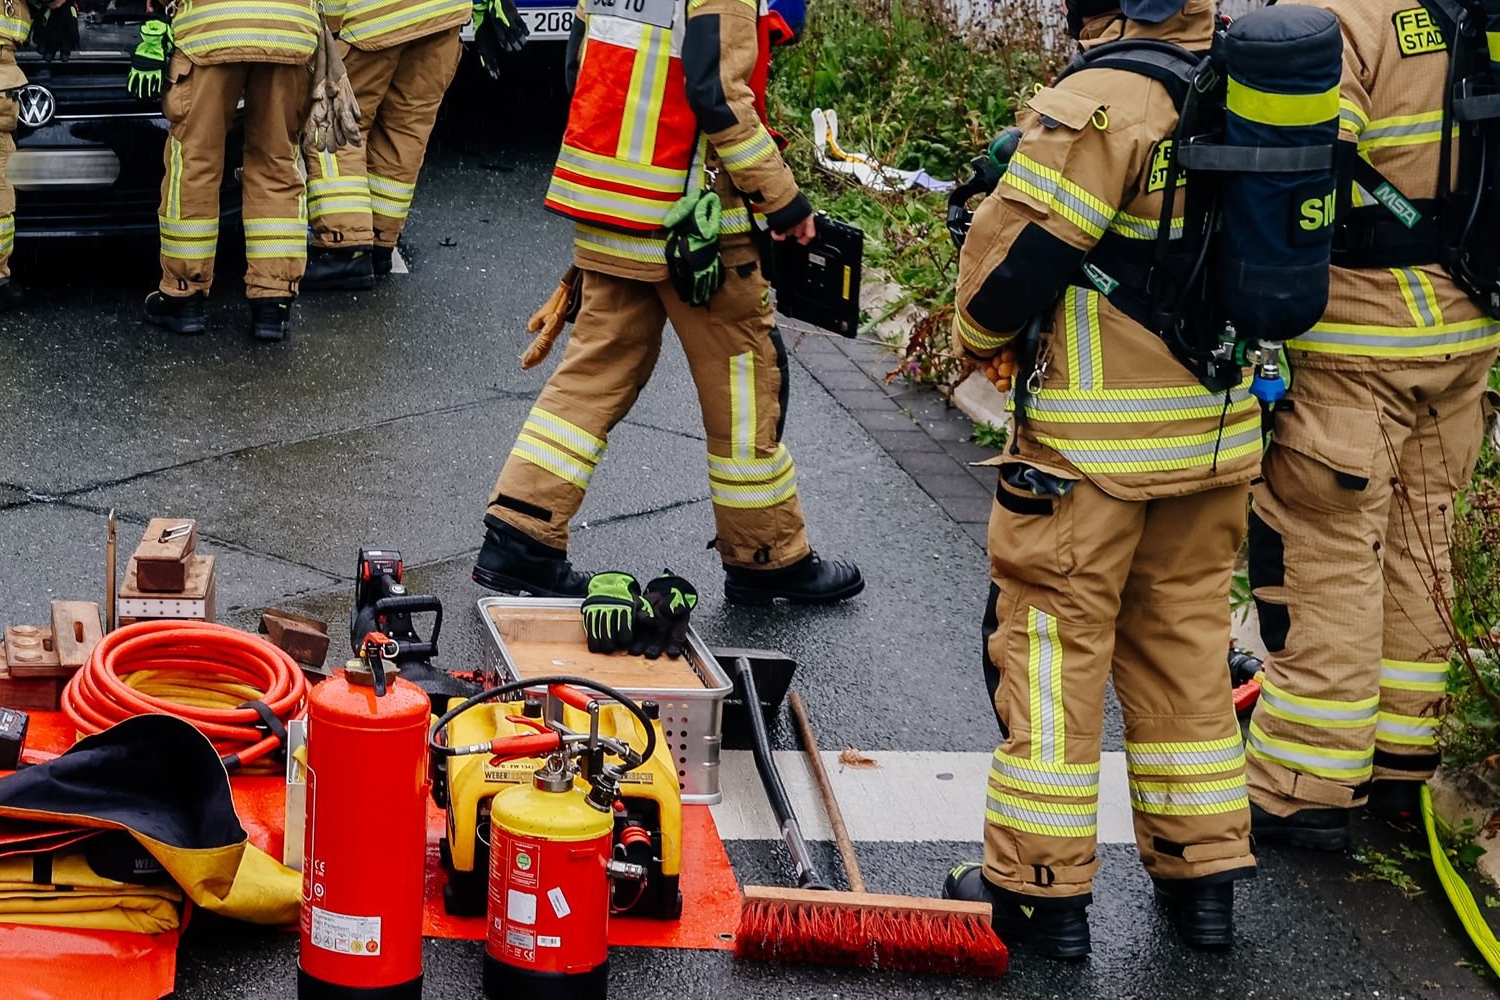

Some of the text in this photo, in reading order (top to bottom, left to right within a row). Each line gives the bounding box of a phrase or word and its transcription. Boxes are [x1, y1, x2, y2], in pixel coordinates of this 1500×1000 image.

[534, 12, 573, 32] 208
[1404, 30, 1444, 50] STAD
[1377, 186, 1417, 226] MSA
[1084, 263, 1112, 293] SA
